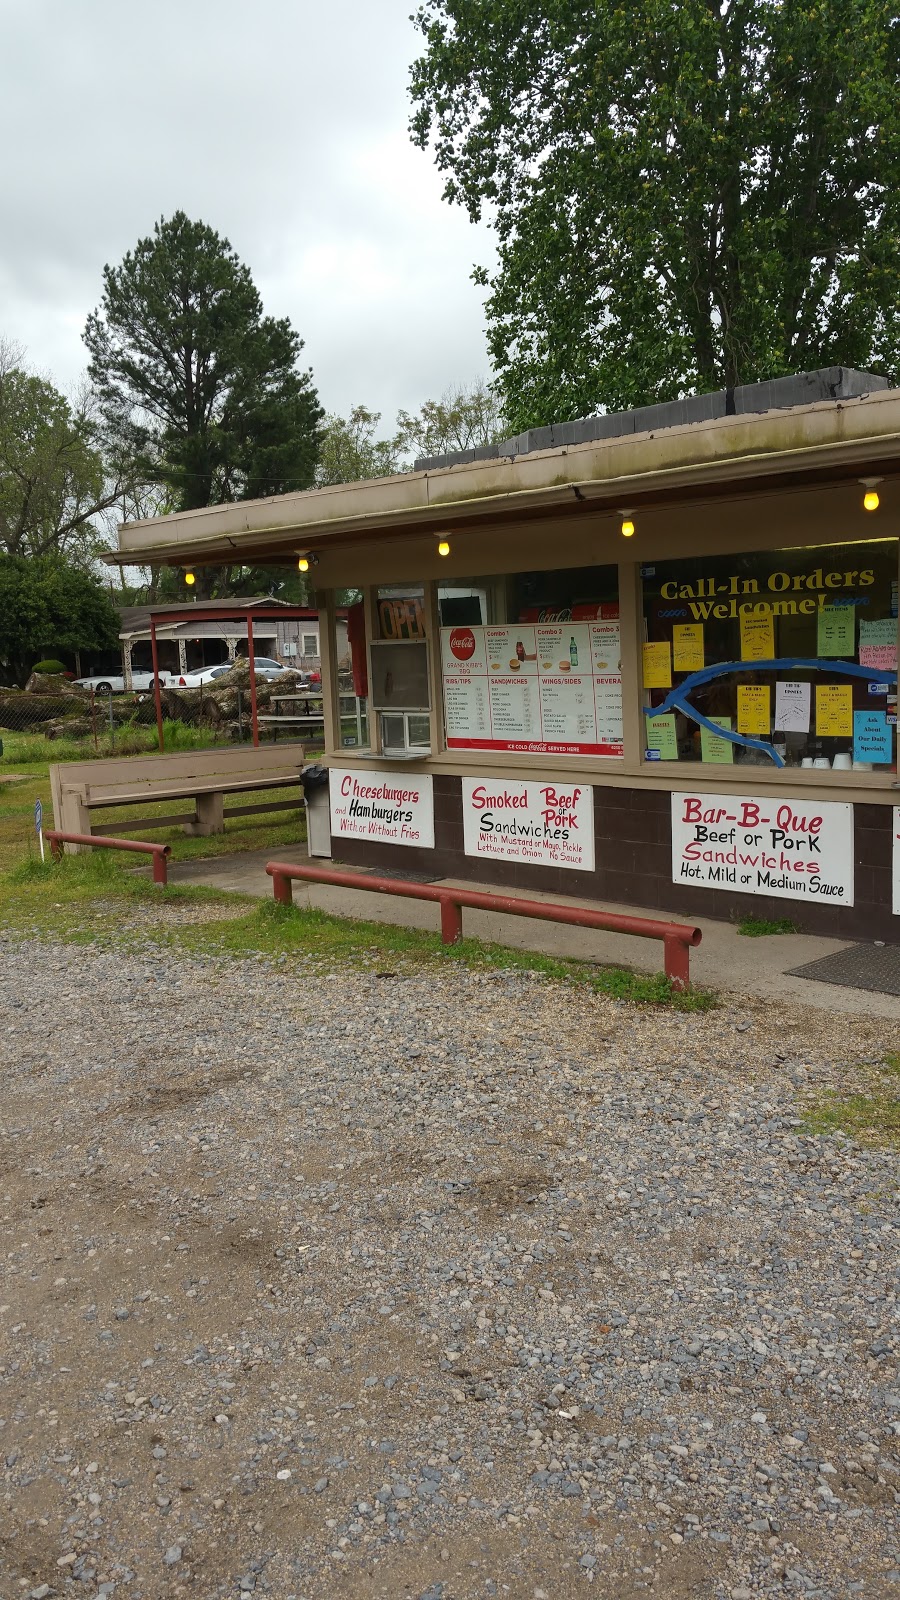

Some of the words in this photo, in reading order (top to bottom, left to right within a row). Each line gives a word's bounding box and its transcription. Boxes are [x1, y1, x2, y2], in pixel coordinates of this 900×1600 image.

[660, 576, 759, 599] Call-In
[768, 568, 875, 592] Orders
[688, 594, 827, 621] Welcome!
[451, 637, 473, 648] Coca-Cola
[872, 736, 886, 744] Daily
[341, 775, 419, 807] Cheeseburgers
[472, 786, 529, 809] Smoked
[540, 787, 582, 809] Beef
[335, 806, 346, 815] and
[349, 799, 413, 823] Hamburgers
[558, 807, 567, 815] or
[340, 818, 358, 832] With
[359, 825, 366, 833] or
[368, 821, 398, 837] Without
[401, 824, 420, 840] Fries
[479, 812, 569, 840] Sandwiches
[694, 825, 736, 844] Beef
[744, 834, 763, 846] or
[477, 841, 505, 853] Lettuce
[507, 847, 520, 855] and
[521, 848, 543, 858] Onion
[549, 851, 558, 860] No
[560, 852, 582, 863] Sauce
[479, 833, 498, 842] With
[501, 835, 533, 846] Mustard
[543, 840, 561, 853] Mayo,
[562, 841, 582, 853] Pickle
[682, 842, 821, 873] Sandwiches
[708, 867, 736, 883] Mild
[740, 876, 752, 884] or
[757, 870, 806, 892] Medium
[809, 875, 844, 896] Sauce
